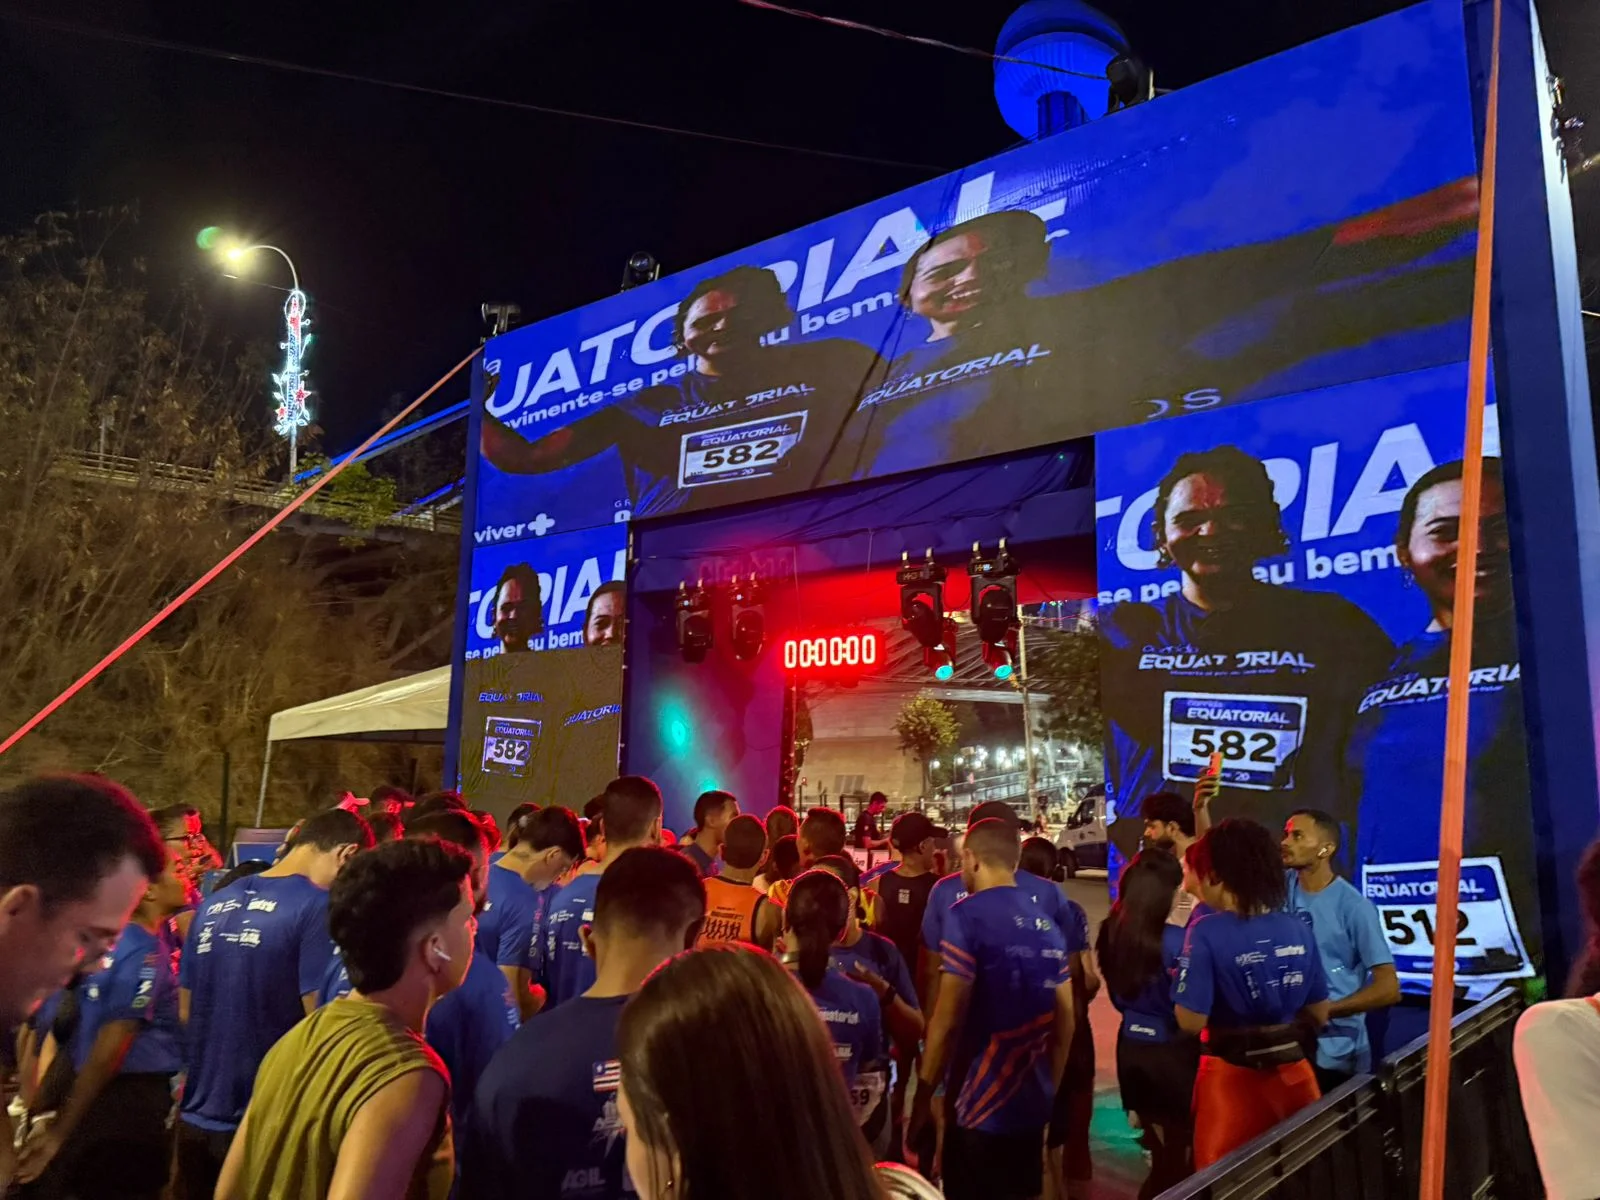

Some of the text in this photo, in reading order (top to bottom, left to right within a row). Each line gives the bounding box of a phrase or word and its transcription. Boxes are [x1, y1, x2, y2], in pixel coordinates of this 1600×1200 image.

[651, 353, 698, 387] pel
[701, 423, 792, 448] EQUATORIAL
[703, 439, 781, 469] 582
[784, 634, 876, 669] 00:00:00
[1187, 706, 1291, 725] EQUATORIAL
[494, 739, 528, 761] 582
[1190, 728, 1277, 764] 582
[1367, 879, 1486, 898] EQUATOAL
